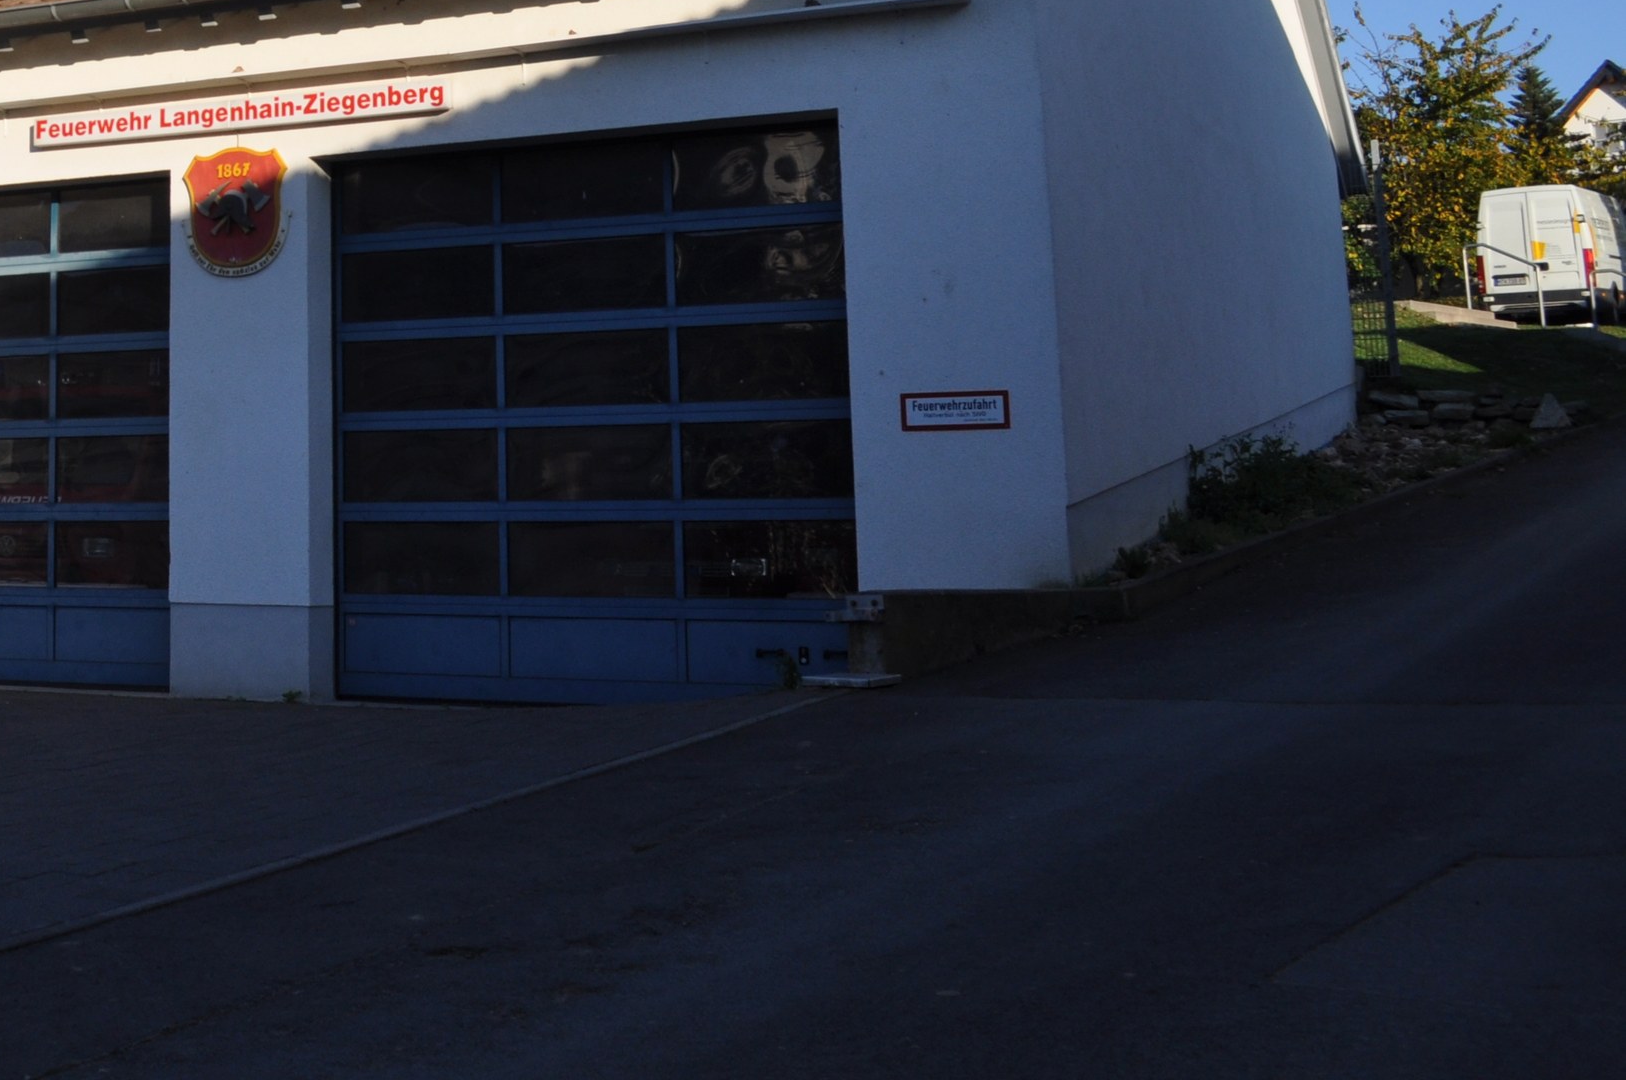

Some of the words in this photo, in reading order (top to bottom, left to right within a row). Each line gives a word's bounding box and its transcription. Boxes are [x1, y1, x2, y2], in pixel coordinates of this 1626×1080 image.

[35, 111, 152, 139] Feuerwehr
[160, 85, 444, 128] Langenhain-Ziegenberg
[217, 163, 250, 179] 1867
[912, 399, 997, 411] Feuerwehrzufahrt
